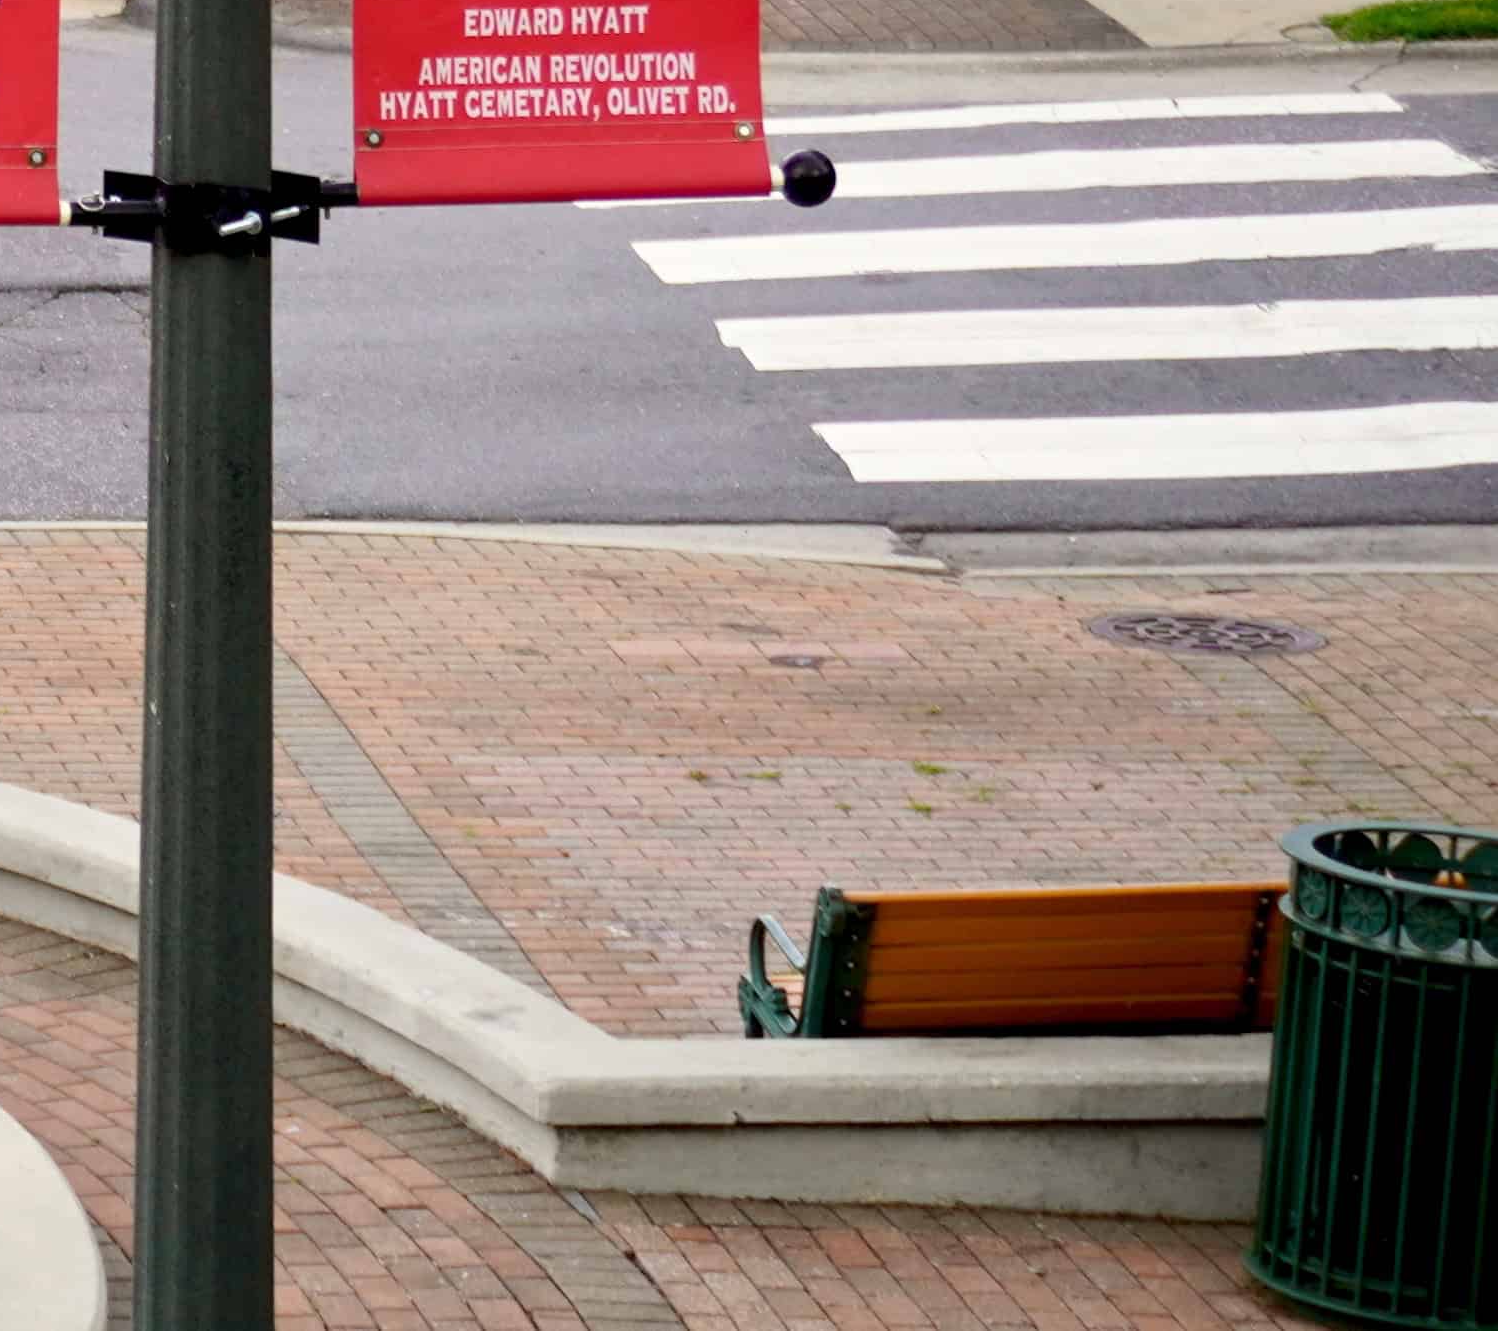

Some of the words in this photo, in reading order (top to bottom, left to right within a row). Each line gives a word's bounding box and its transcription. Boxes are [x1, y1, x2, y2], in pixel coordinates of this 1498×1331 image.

[464, 7, 564, 37] EDWARD
[571, 5, 649, 35] HYATT
[418, 55, 541, 86] AMERICAN
[550, 52, 696, 83] REVOLUTION
[380, 89, 458, 120] HYATT
[464, 88, 600, 122] CEMETARY,
[607, 85, 690, 116] OLIVET
[697, 84, 737, 114] RD.
